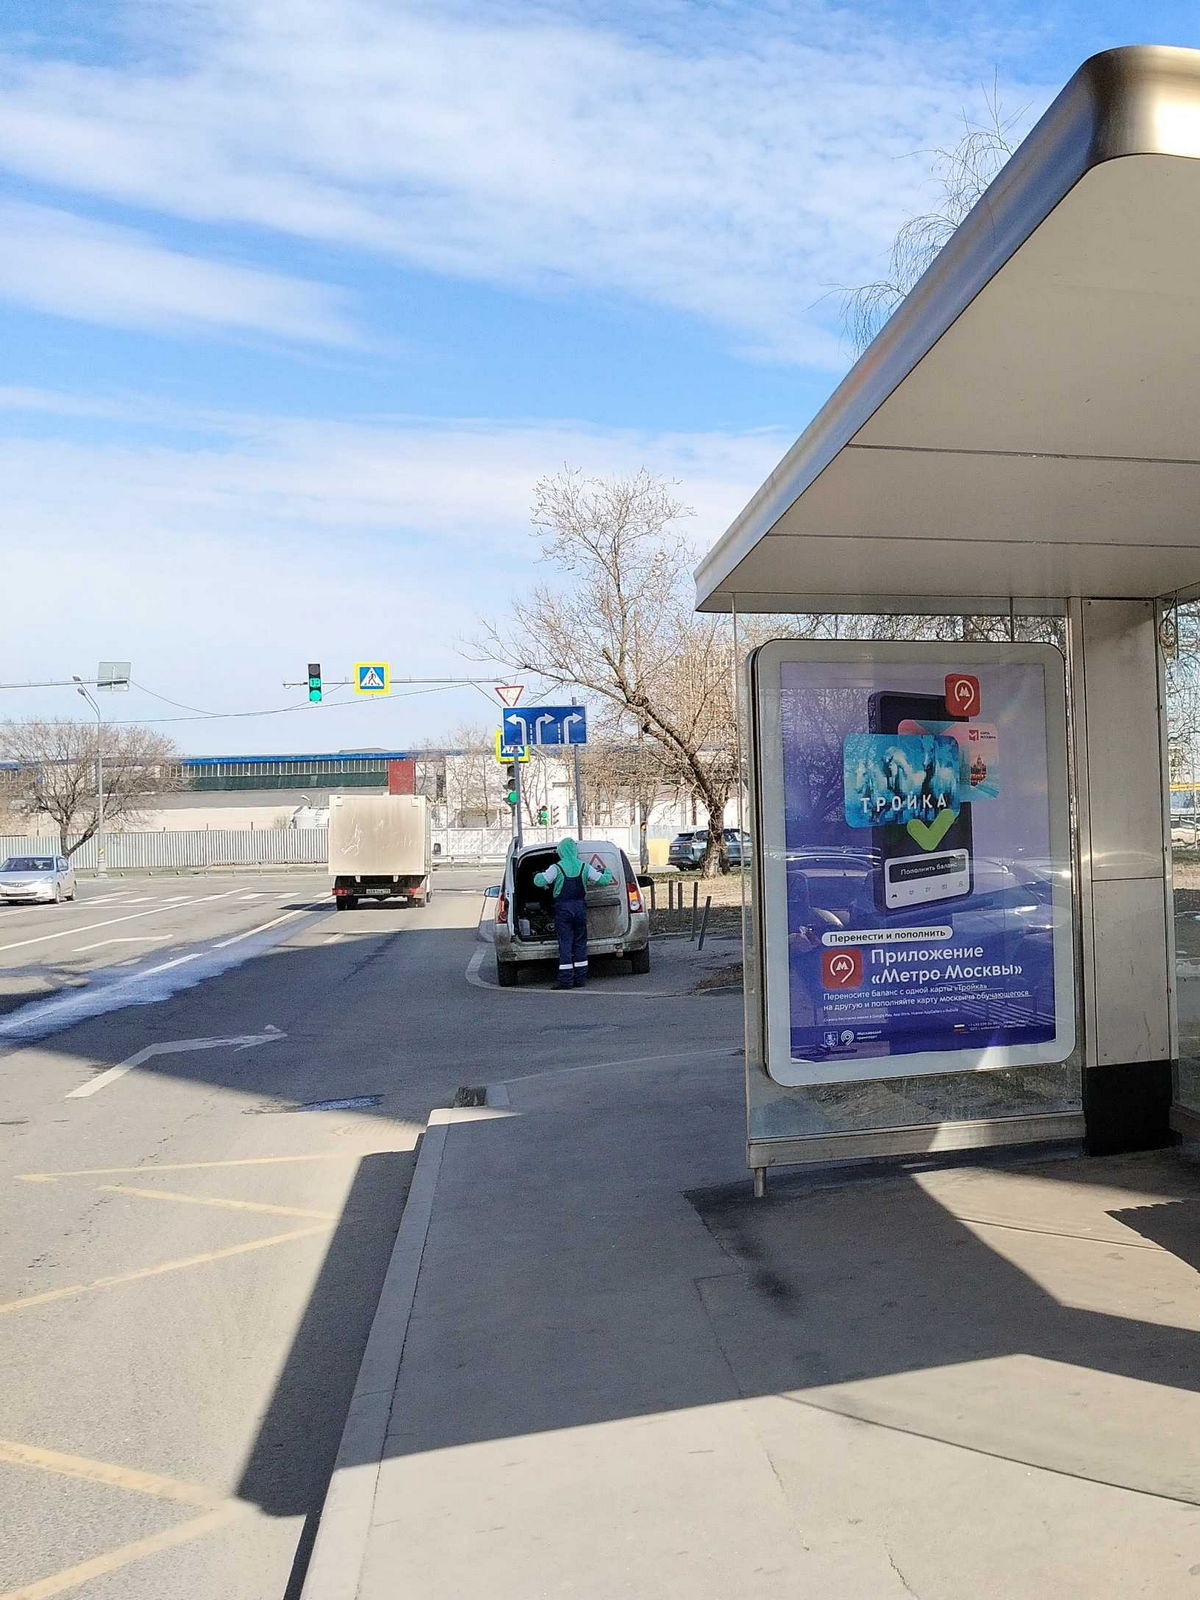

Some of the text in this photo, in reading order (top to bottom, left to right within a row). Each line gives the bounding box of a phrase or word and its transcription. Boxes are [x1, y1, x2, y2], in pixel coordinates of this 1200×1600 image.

[859, 791, 948, 813] ТРОЙКА
[900, 865, 936, 876] Пополнить
[829, 932, 884, 944] Перенести
[894, 929, 946, 940] пополнить
[871, 946, 984, 966] Приложение
[871, 963, 1023, 984] «Метро Москвы»
[823, 991, 870, 1001] Переносите
[871, 989, 898, 998] баланс
[905, 986, 928, 995] одной
[929, 985, 952, 993] карты
[834, 1002, 863, 1011] другую
[871, 997, 915, 1007] пополняйте
[916, 996, 938, 1005] карту
[939, 993, 975, 1002] москвича
[976, 990, 1030, 1001] обучающегося
